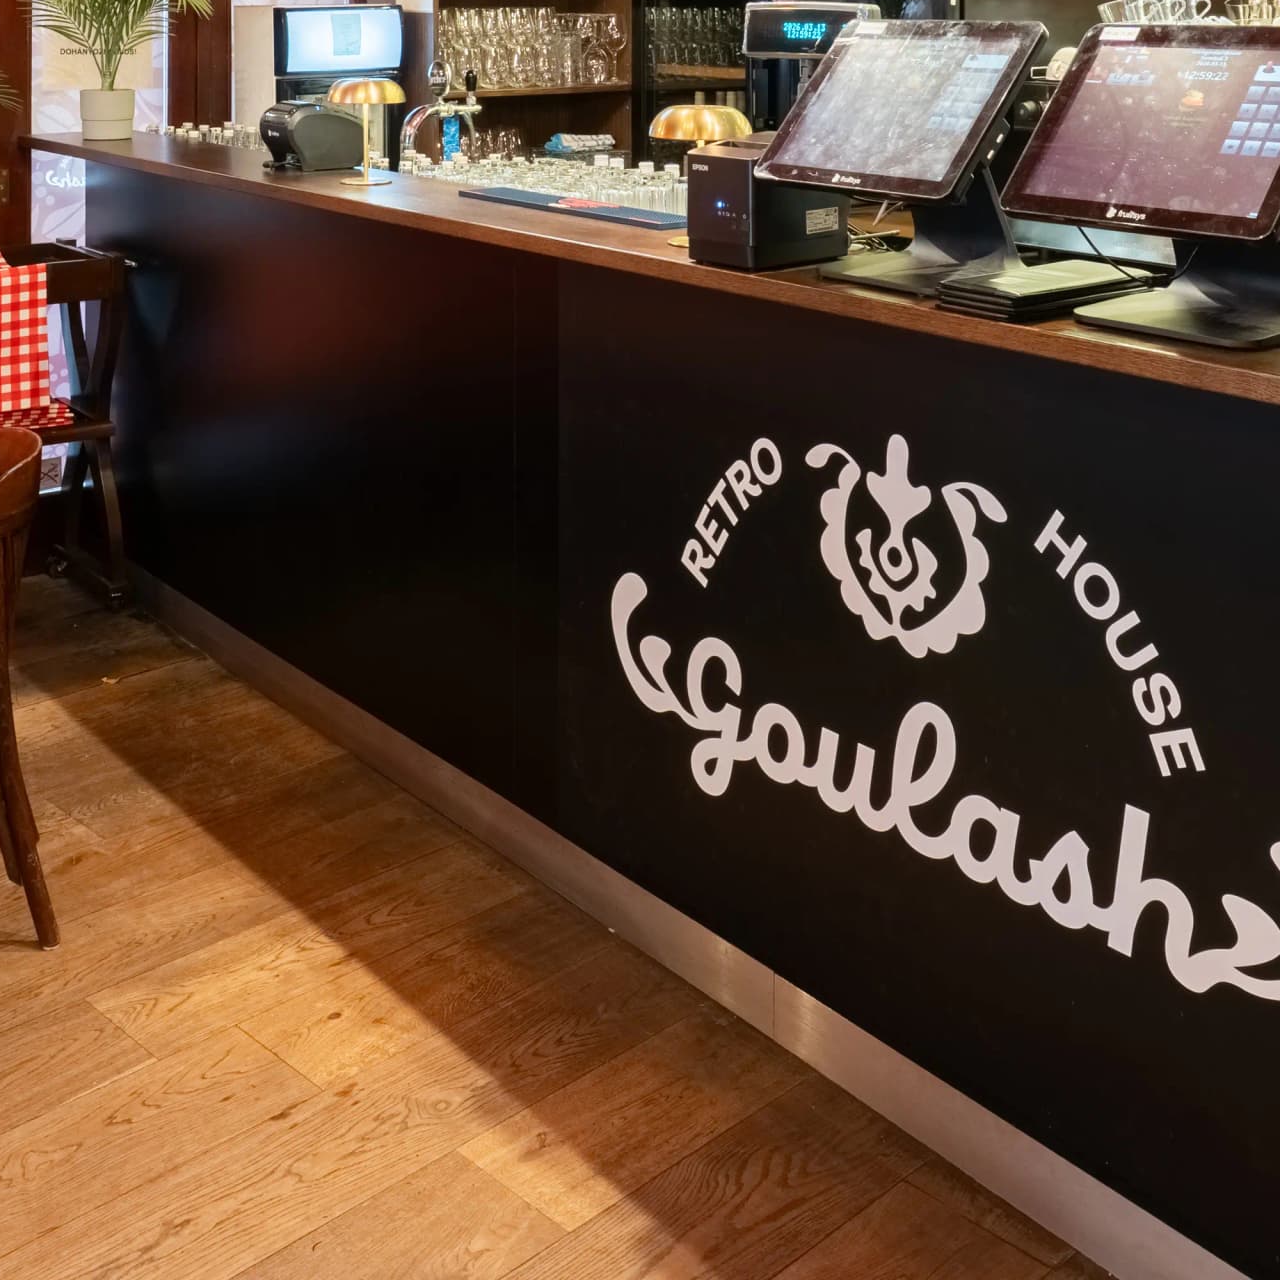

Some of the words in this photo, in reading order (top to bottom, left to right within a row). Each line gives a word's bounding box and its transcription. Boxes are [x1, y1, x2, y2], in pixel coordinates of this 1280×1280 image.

[692, 163, 709, 172] EPSON
[680, 437, 783, 588] RETRO
[1032, 509, 1206, 777] HOUSE
